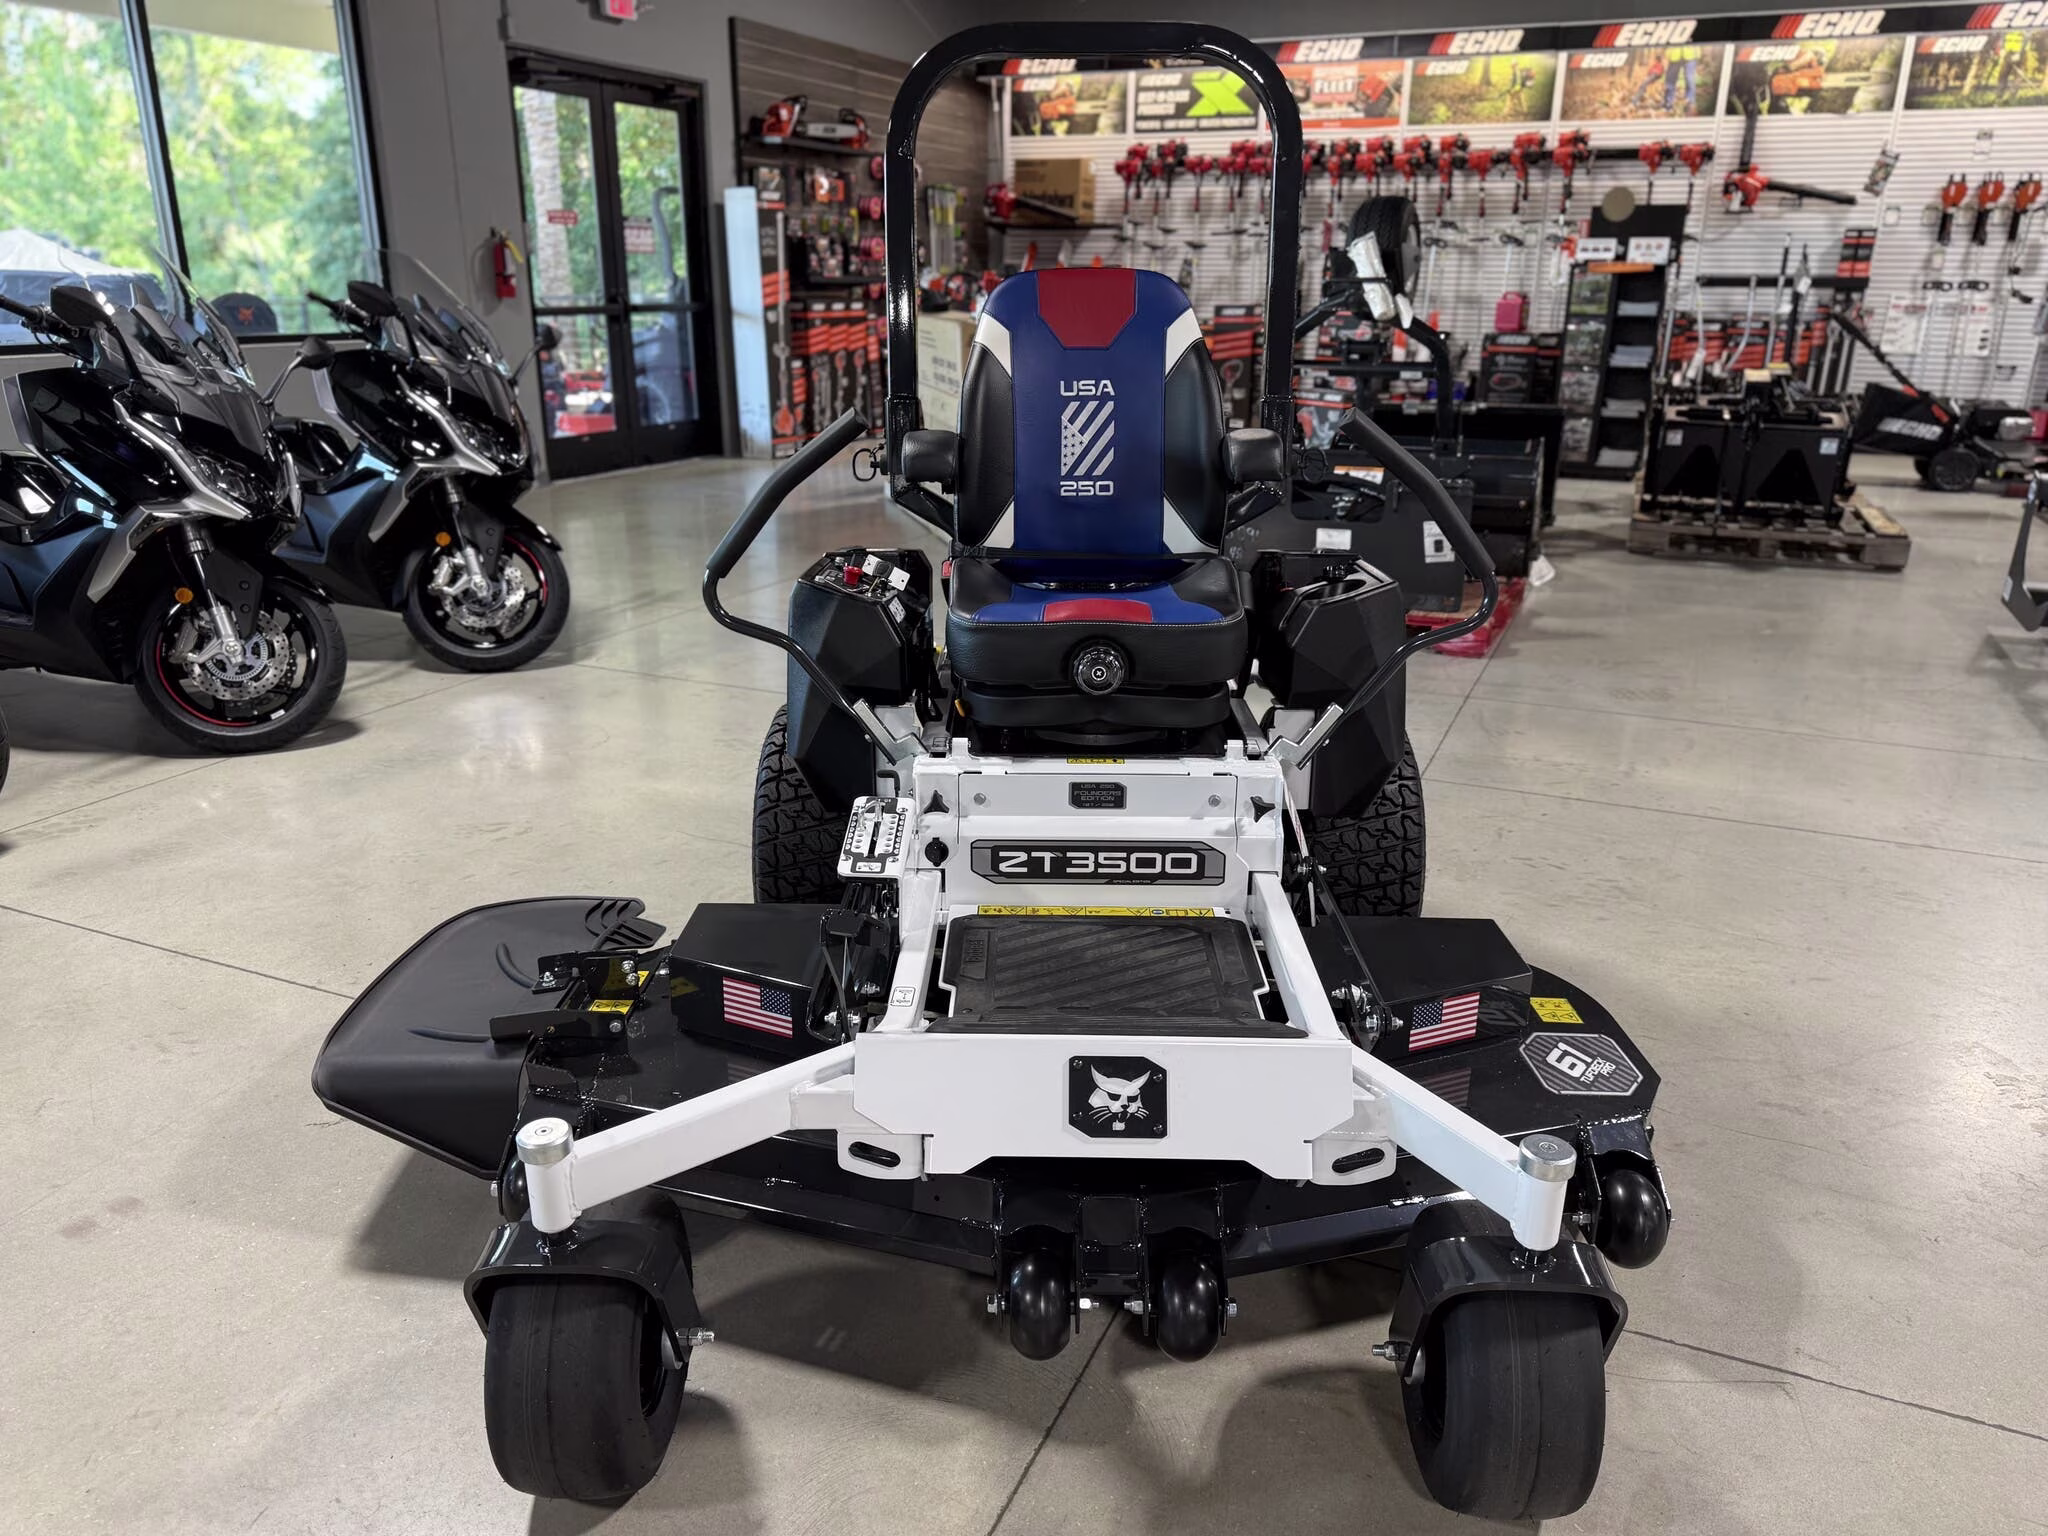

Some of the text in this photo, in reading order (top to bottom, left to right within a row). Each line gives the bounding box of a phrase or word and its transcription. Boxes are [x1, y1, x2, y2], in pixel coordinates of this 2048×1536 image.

[1794, 9, 1885, 38] ECHO
[1991, 1, 2048, 28] ECH
[1447, 29, 1524, 55] ECHO
[1614, 19, 1698, 47] ECHO
[1929, 35, 1988, 54] ECHO
[1294, 38, 1364, 63] ECHO
[1580, 52, 1628, 69] ECHO
[1748, 45, 1800, 62] ECHO
[1425, 59, 1469, 76] ECHO
[1313, 79, 1354, 95] FLEET
[1060, 380, 1115, 396] USA
[1891, 417, 1943, 441] ECHO
[1060, 480, 1114, 496] 250
[999, 851, 1198, 874] ZT 3500
[1545, 1041, 1593, 1078] 61
[1580, 1056, 1606, 1084] TUFDECK
[1600, 1061, 1616, 1077] PRO
